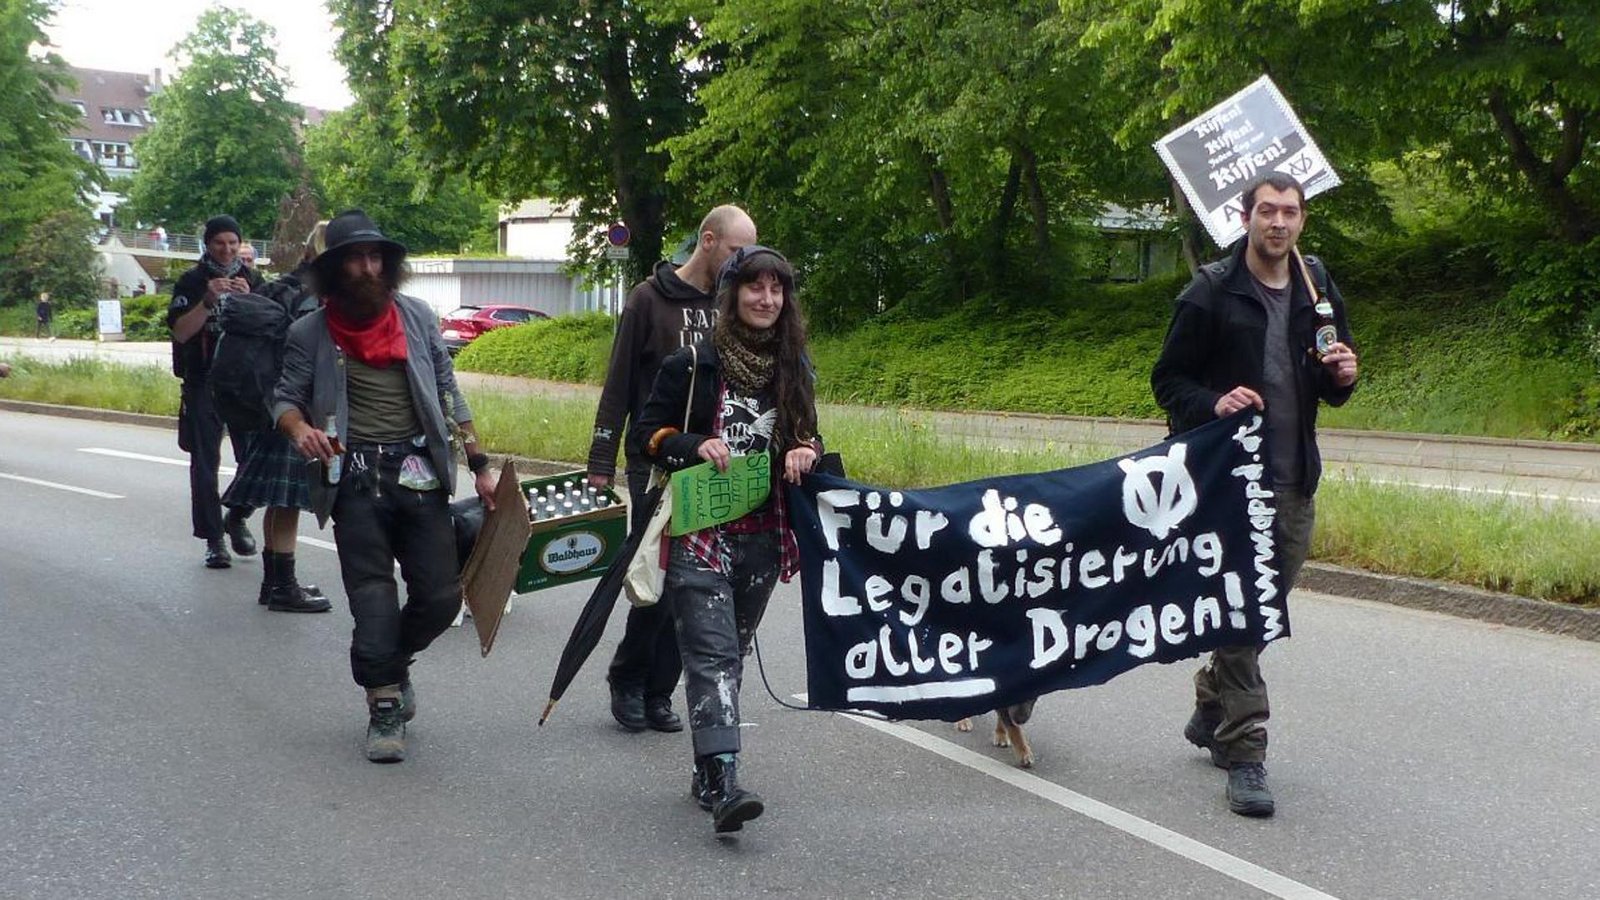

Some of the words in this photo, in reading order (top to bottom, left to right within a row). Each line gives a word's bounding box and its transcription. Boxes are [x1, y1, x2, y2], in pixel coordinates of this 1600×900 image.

[1194, 103, 1243, 139] Kiffen!
[1204, 119, 1254, 155] Kiffen!
[1208, 136, 1288, 191] Kiffen!
[708, 465, 731, 519] WEED
[816, 488, 949, 554] Für
[968, 488, 1063, 548] die
[1231, 415, 1284, 642] www.appd.at
[548, 546, 598, 564] Waldhaus
[845, 623, 993, 680] aller
[1026, 571, 1246, 670] Drogen!
